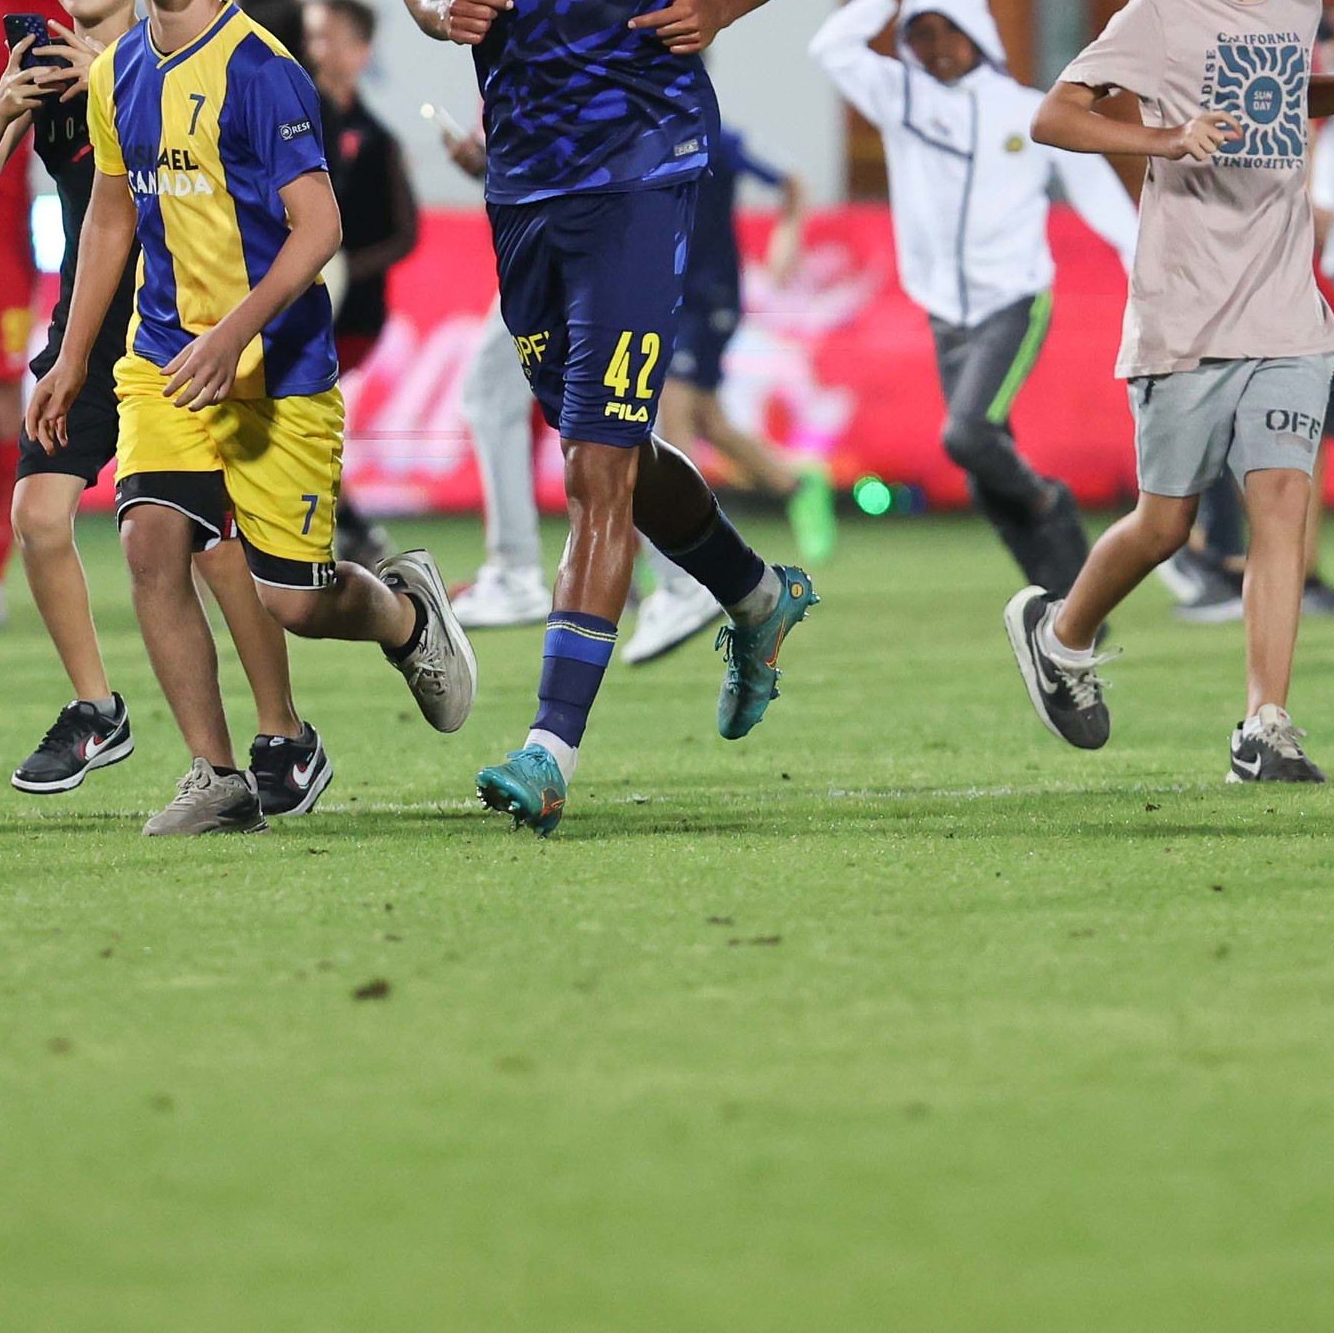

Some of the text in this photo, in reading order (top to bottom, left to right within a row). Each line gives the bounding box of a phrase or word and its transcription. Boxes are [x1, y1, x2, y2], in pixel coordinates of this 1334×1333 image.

[1200, 50, 1216, 111] ADISE
[1253, 91, 1273, 100] SUN
[188, 93, 206, 136] 7
[1253, 101, 1272, 111] DAY
[1212, 155, 1303, 170] CALIFORNIA
[603, 331, 660, 399] 42
[605, 401, 649, 423] FILA
[301, 494, 318, 535] 7
